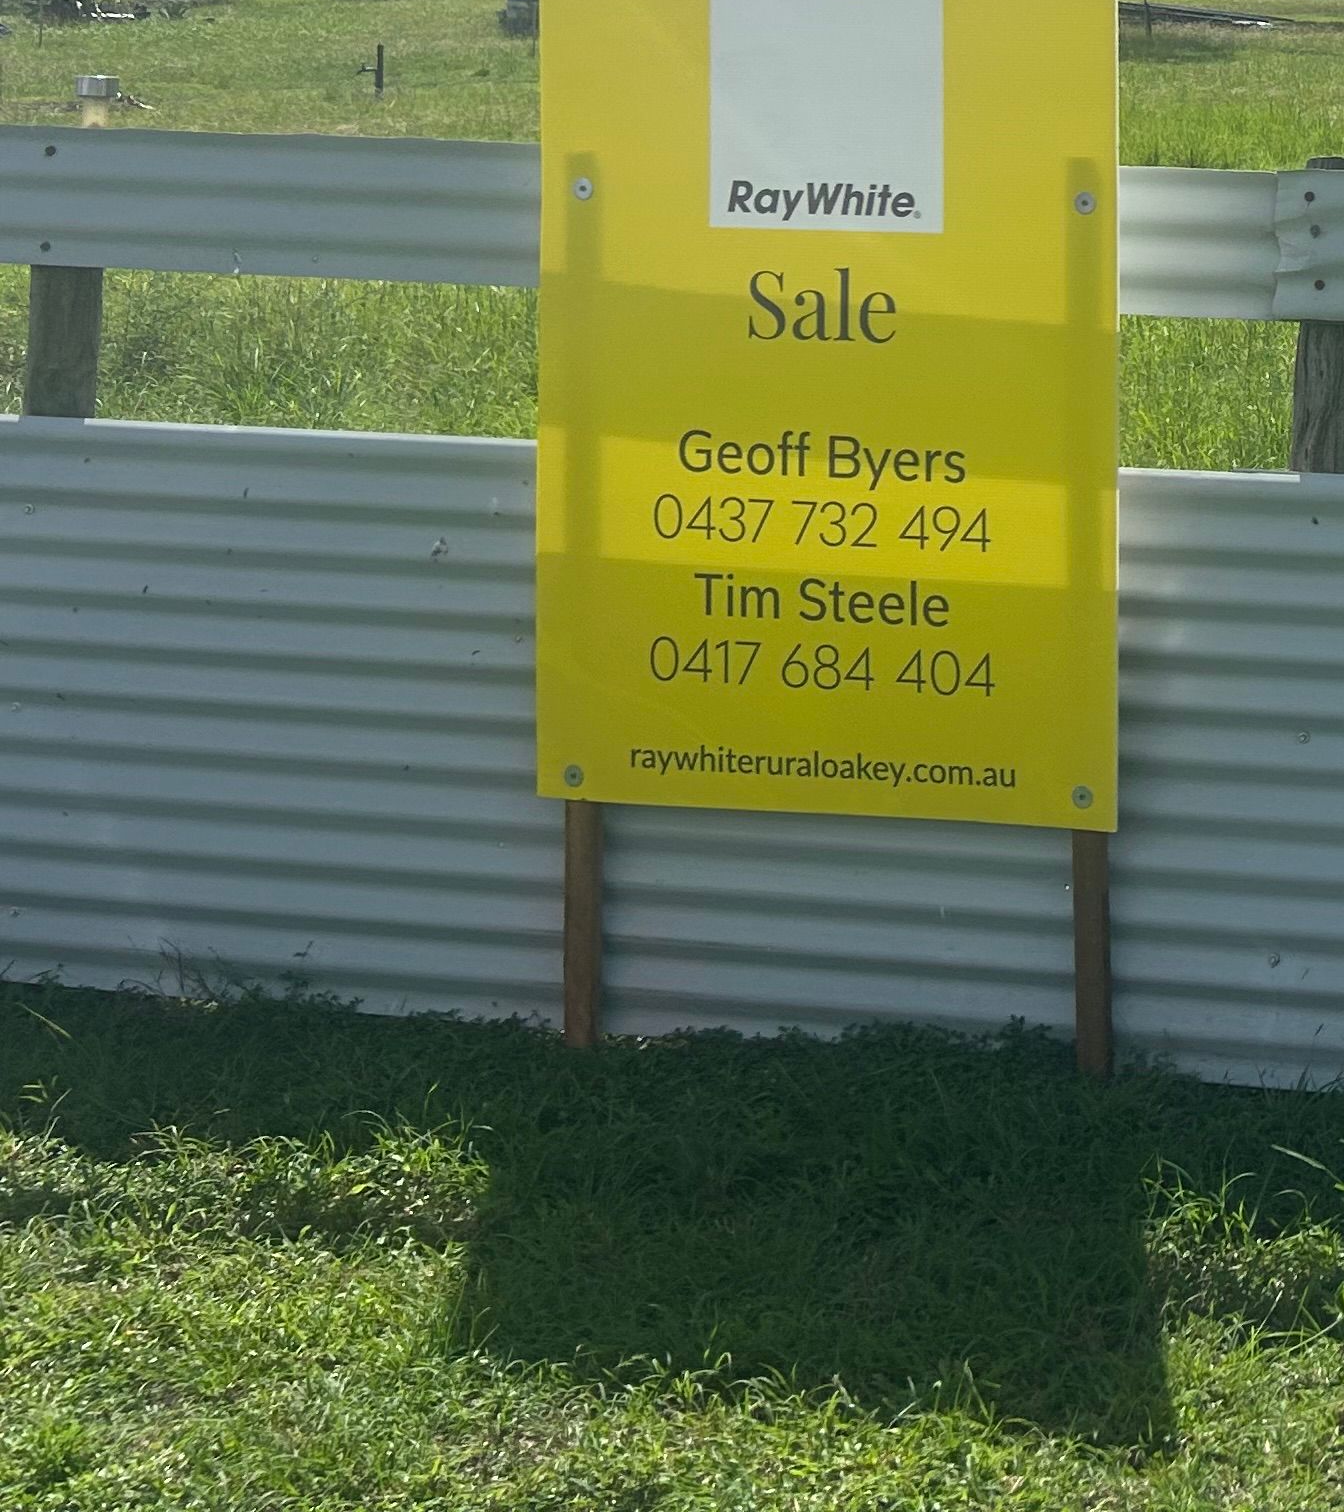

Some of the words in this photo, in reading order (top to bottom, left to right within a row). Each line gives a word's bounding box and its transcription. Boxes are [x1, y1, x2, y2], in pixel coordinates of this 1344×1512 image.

[748, 268, 898, 344] Sale
[677, 429, 811, 481] Geoff
[827, 434, 967, 492] Byers
[652, 492, 776, 544] 0437
[790, 498, 879, 549] 732
[897, 504, 993, 554] 494
[693, 572, 781, 621] Tim
[798, 577, 951, 629] Steele
[649, 634, 763, 687] 0417
[780, 642, 876, 692] 684
[894, 648, 997, 698] 404
[629, 743, 1018, 790] raywhiteruraloakey.com.au
